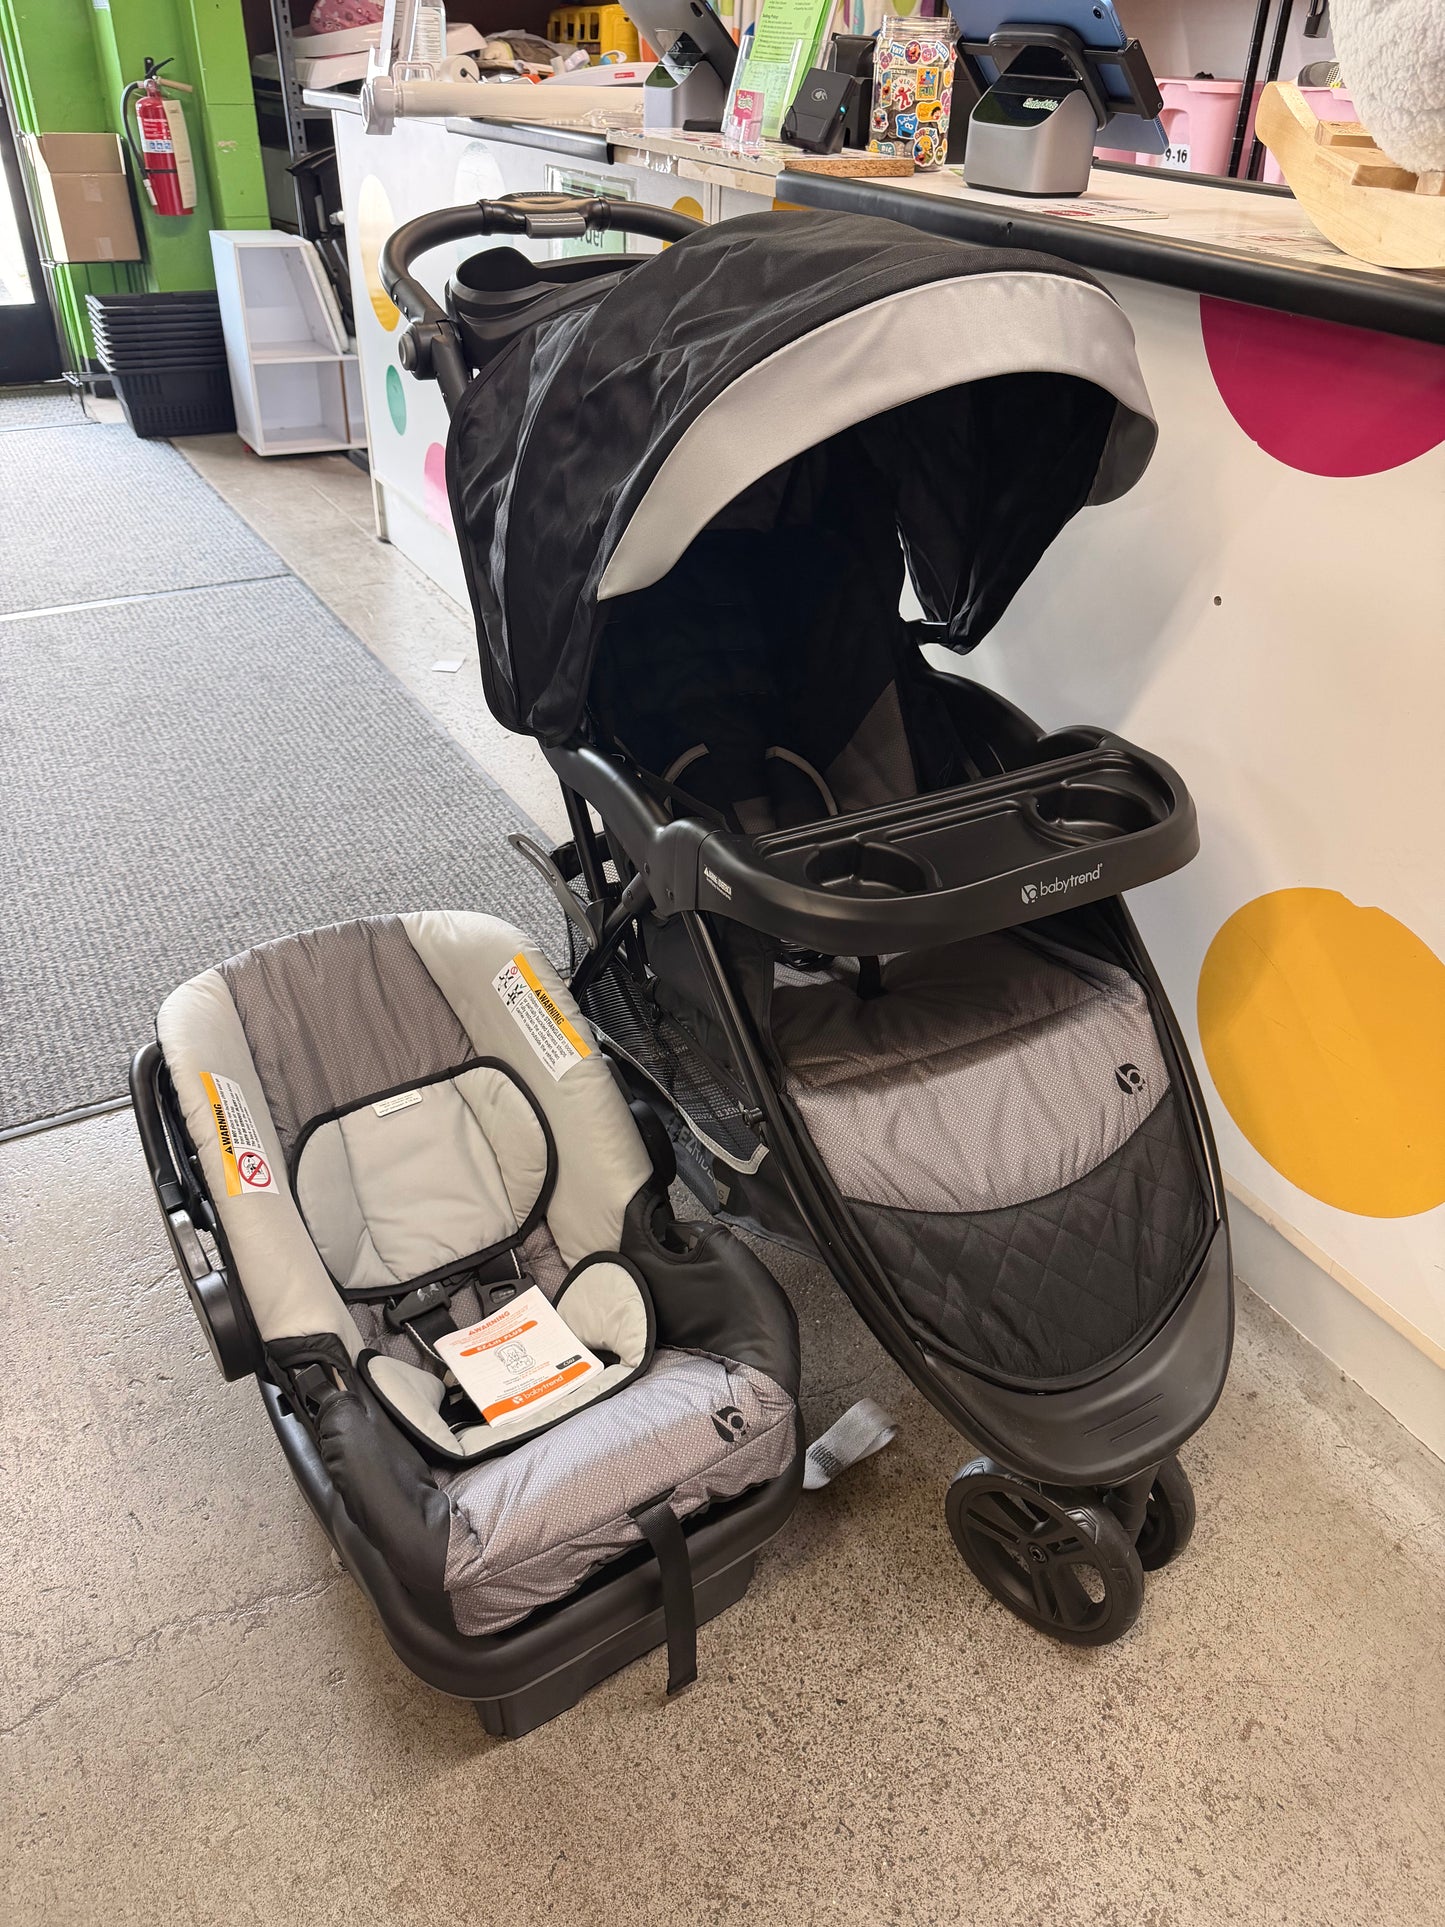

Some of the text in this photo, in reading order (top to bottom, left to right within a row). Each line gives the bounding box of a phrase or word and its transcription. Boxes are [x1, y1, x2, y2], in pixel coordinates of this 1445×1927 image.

[1040, 863, 1099, 896] babytrend
[538, 992, 565, 1025] WARNING
[213, 1104, 231, 1145] WARNING
[474, 1311, 511, 1333] WARNING
[502, 1328, 523, 1340] PLUS
[523, 1375, 564, 1399] babytrend
